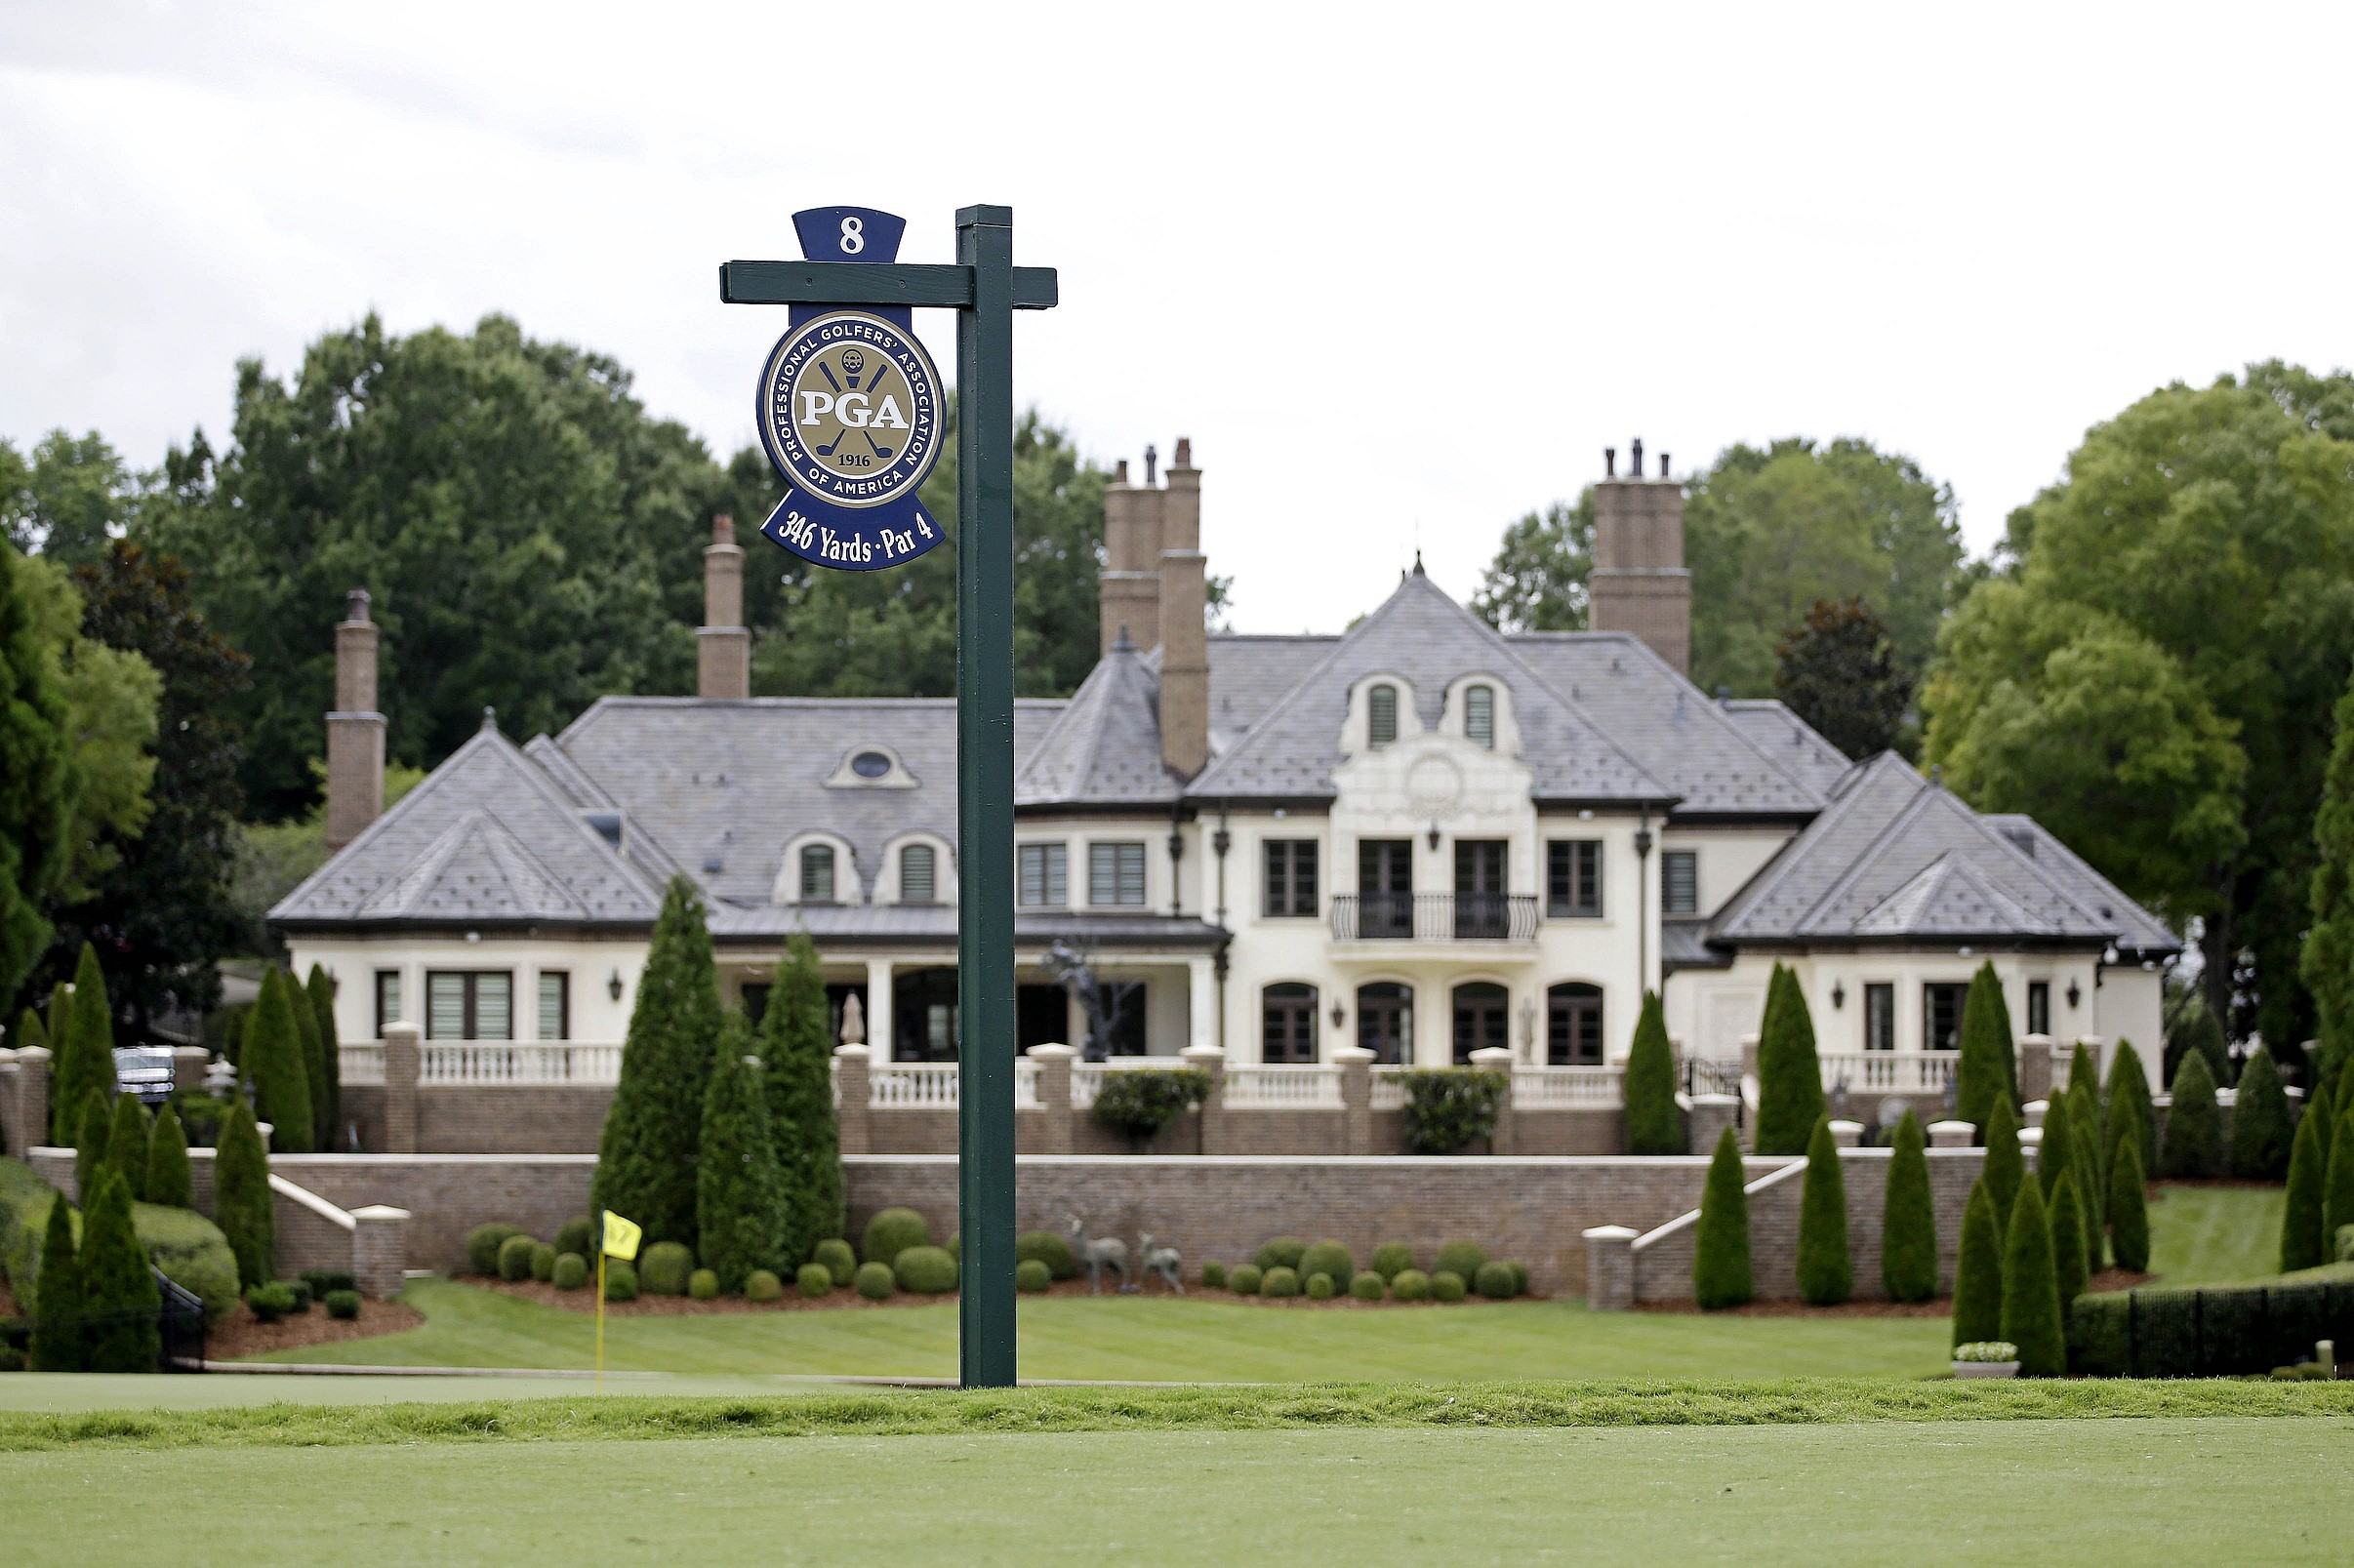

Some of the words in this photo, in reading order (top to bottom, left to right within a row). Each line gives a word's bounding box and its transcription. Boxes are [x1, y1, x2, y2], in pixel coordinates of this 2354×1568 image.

[839, 216, 865, 255] 8
[777, 338, 818, 462] PROFESSIONAL
[897, 352, 929, 465] ASSOCIATION
[799, 390, 910, 429] PGA
[837, 453, 871, 467] 1916
[808, 467, 830, 485] OF
[832, 469, 903, 495] AMERICA
[778, 510, 817, 550] 346
[819, 526, 872, 563] Yards
[879, 527, 917, 559] Par
[914, 512, 934, 540] 4
